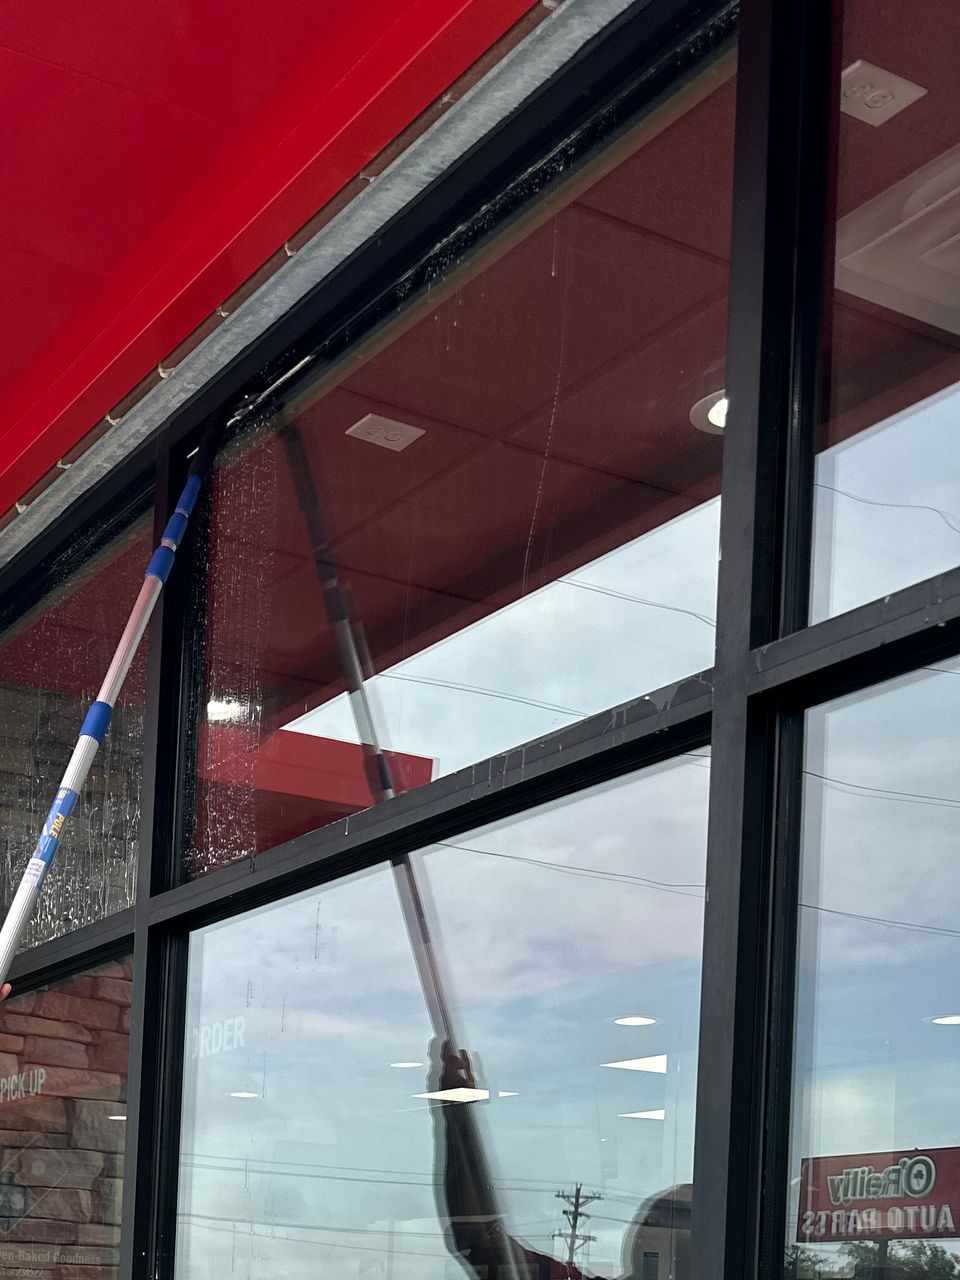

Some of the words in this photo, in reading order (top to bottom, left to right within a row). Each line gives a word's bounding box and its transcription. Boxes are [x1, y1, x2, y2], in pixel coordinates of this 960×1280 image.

[49, 813, 65, 838] POLE
[0, 1074, 26, 1103] PICK
[29, 1068, 46, 1096] UP
[53, 1250, 102, 1265] Goodness
